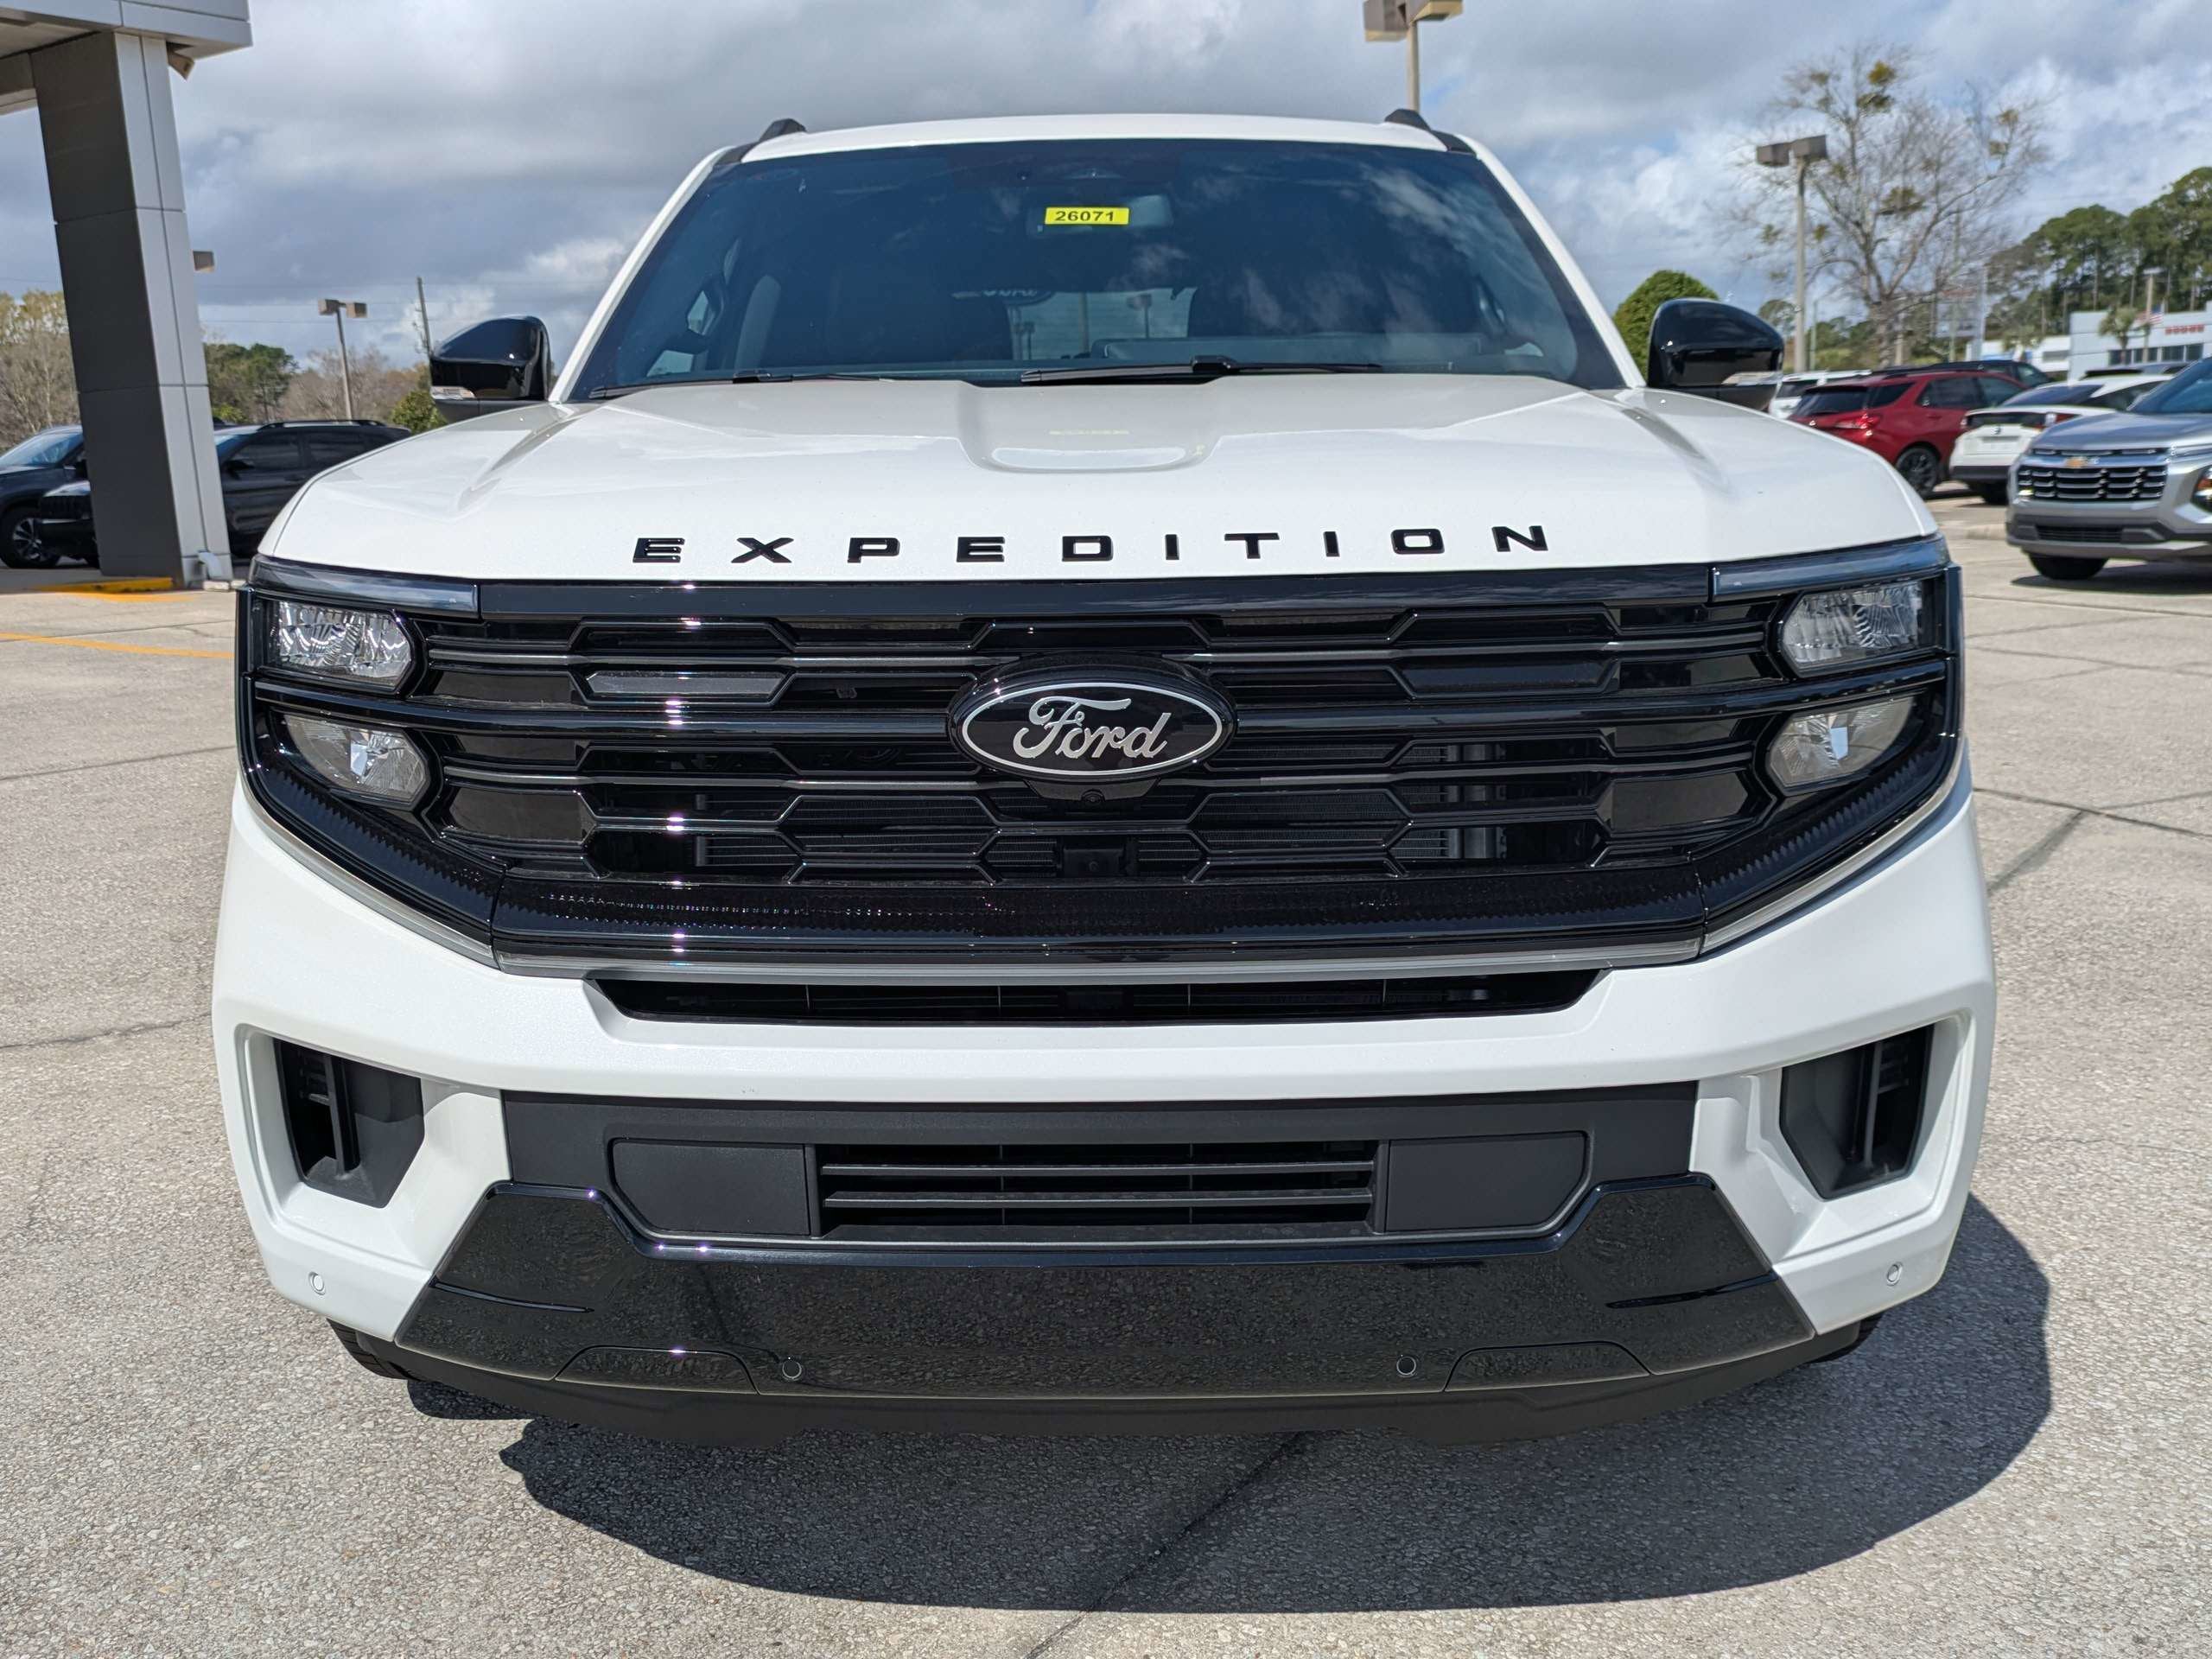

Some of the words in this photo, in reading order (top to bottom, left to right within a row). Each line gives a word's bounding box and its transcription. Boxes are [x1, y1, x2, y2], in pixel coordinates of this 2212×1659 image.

[1055, 211, 1115, 222] 26071
[632, 525, 1548, 563] EXPEDITION
[1013, 696, 1172, 759] Ford
